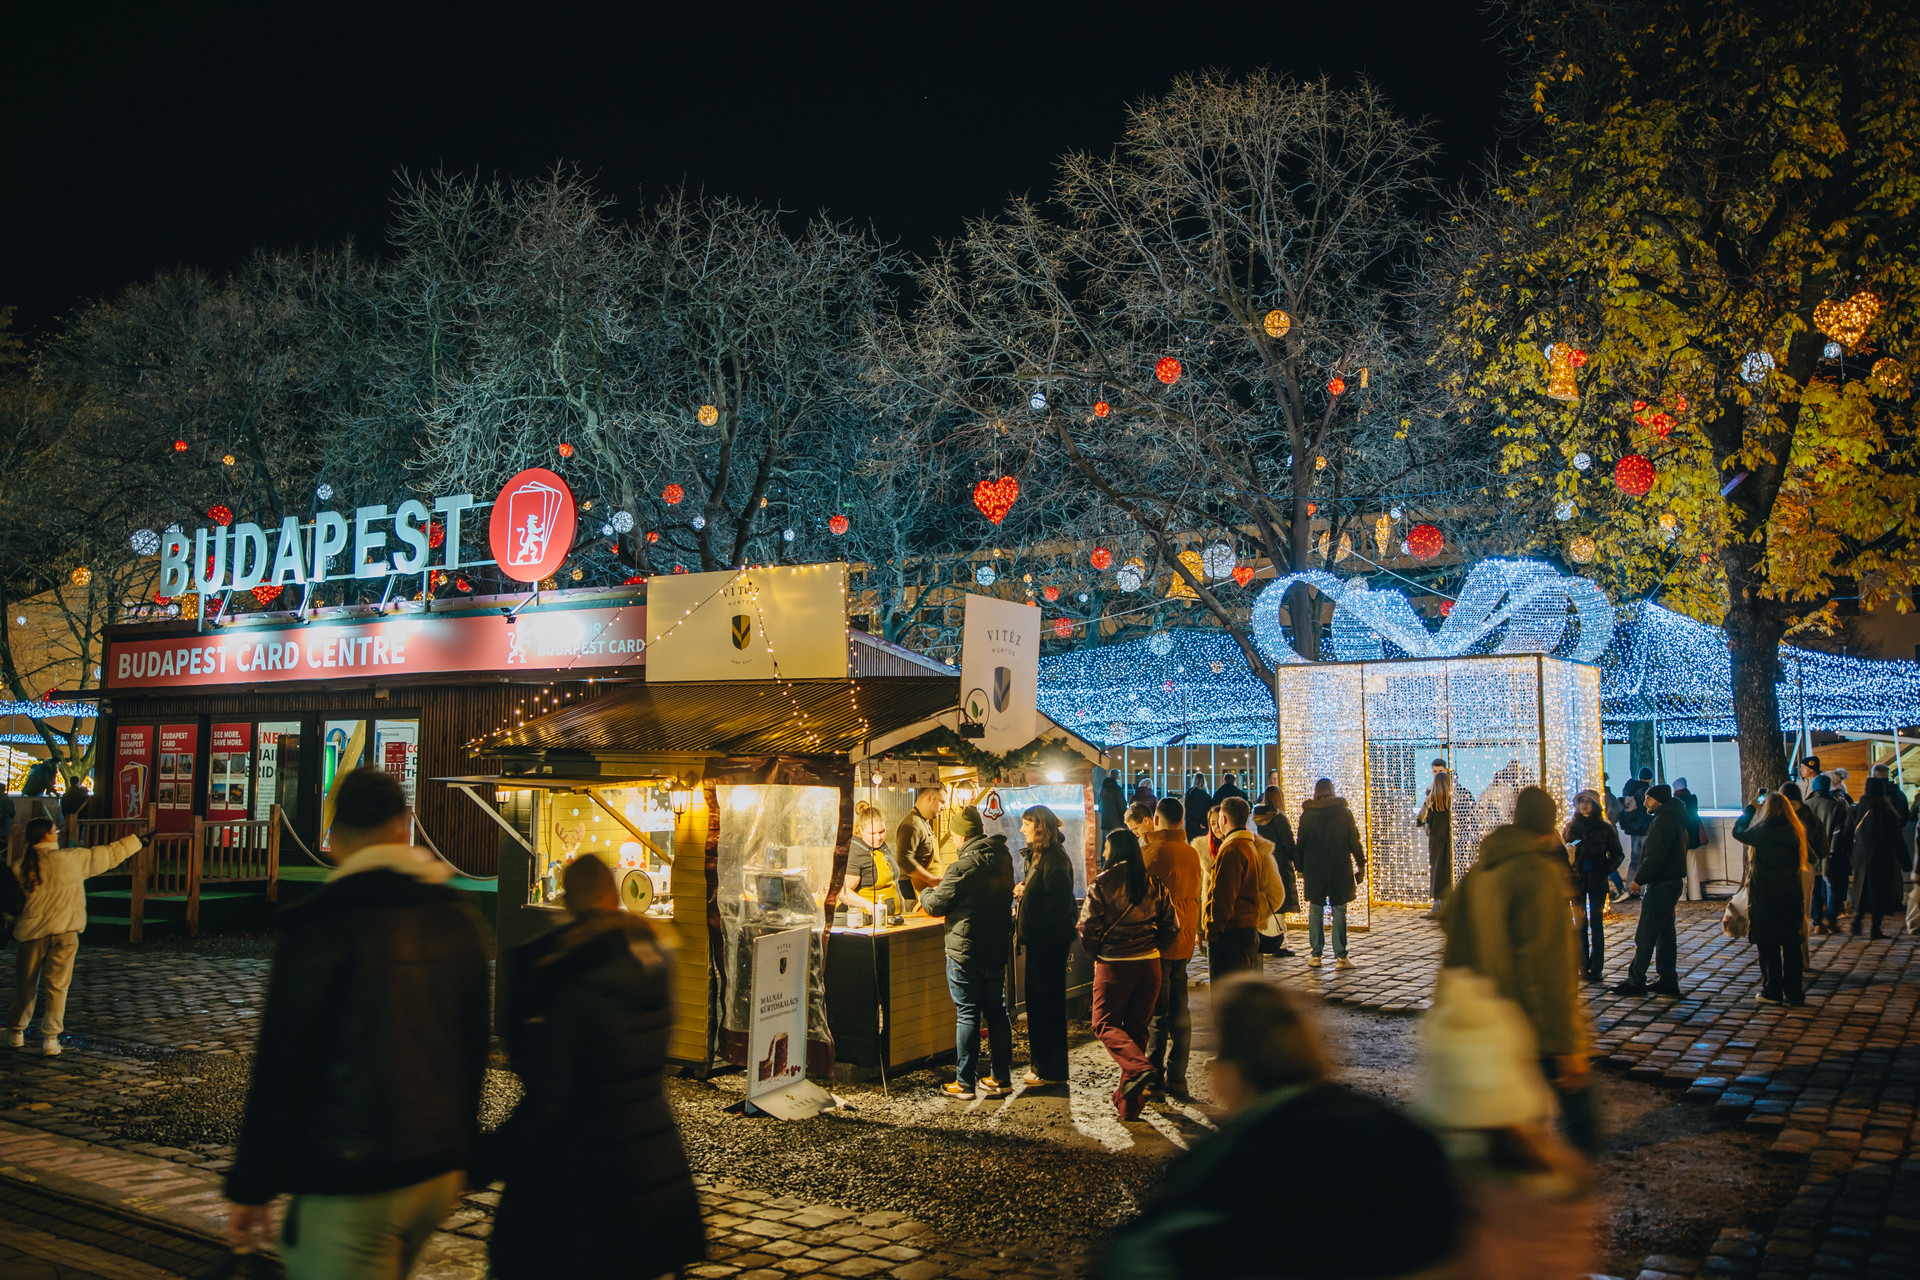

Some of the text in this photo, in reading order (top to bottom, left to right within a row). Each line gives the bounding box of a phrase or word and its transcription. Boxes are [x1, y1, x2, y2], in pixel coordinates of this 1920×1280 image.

[160, 493, 473, 598] BUDAPEST
[987, 629, 1021, 646] VITÉZ
[536, 638, 646, 657] BUDAPEST CARD
[117, 636, 406, 680] BUDAPEST CARD CENTRE
[120, 740, 145, 748] BUDAPEST
[162, 732, 189, 740] BUDAPEST
[227, 738, 244, 746] MORE.
